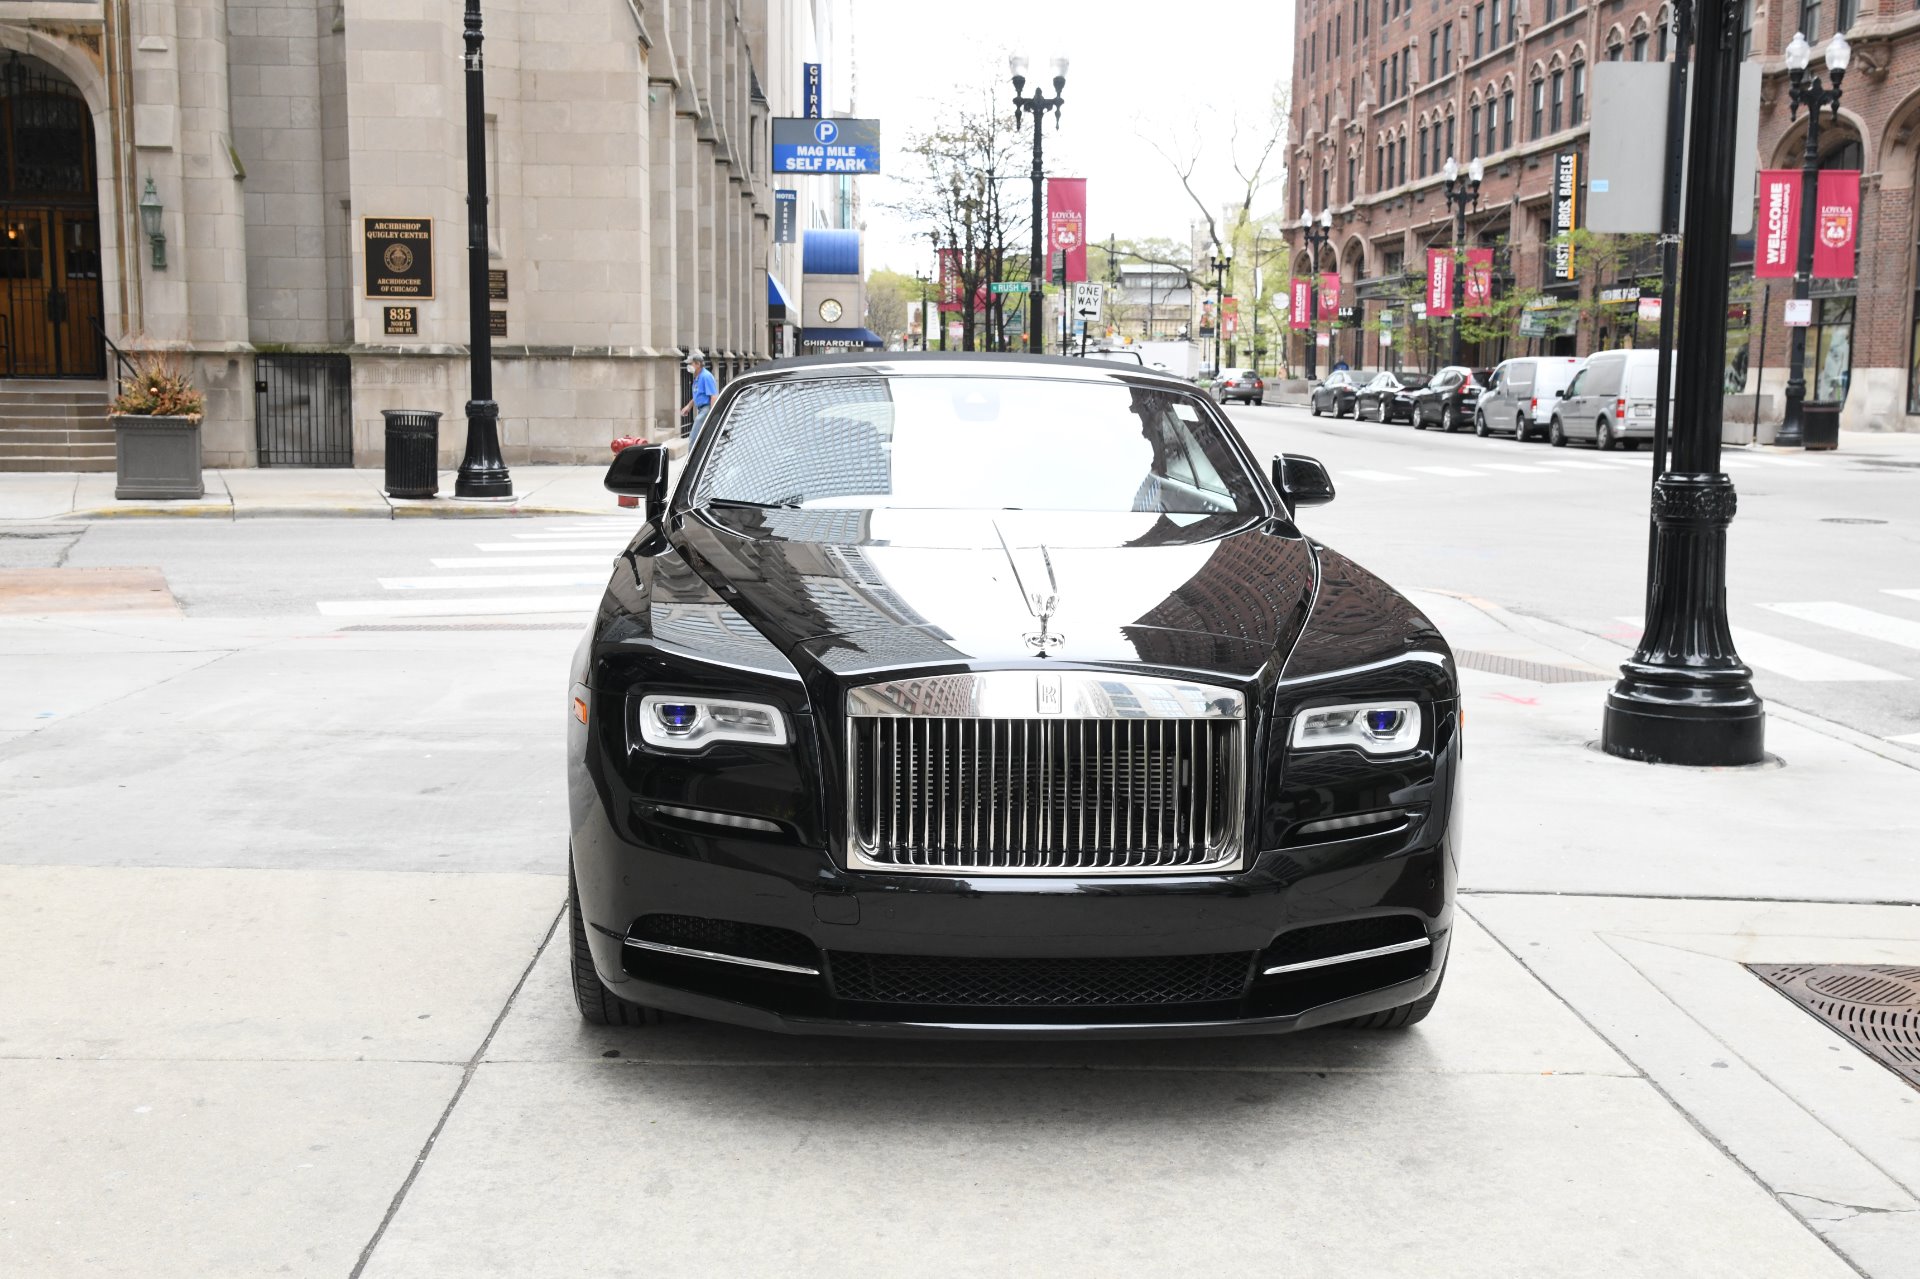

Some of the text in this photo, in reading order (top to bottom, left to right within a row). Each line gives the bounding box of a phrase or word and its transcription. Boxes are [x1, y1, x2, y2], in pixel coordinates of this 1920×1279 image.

[820, 123, 833, 141] P
[797, 146, 856, 157] MAG MILE
[785, 158, 867, 171] SELF PARK
[1559, 155, 1573, 196] BAGELS
[1767, 183, 1782, 264] WELCOME
[367, 231, 428, 239] QUIGLEY CENTER
[1556, 230, 1569, 277] EINSTEN
[998, 284, 1019, 292] RUSH
[1433, 257, 1443, 308] WELCOME
[1078, 286, 1099, 296] ONE
[1078, 297, 1099, 306] WAY
[1295, 284, 1303, 322] WELCOME
[389, 308, 411, 320] 835
